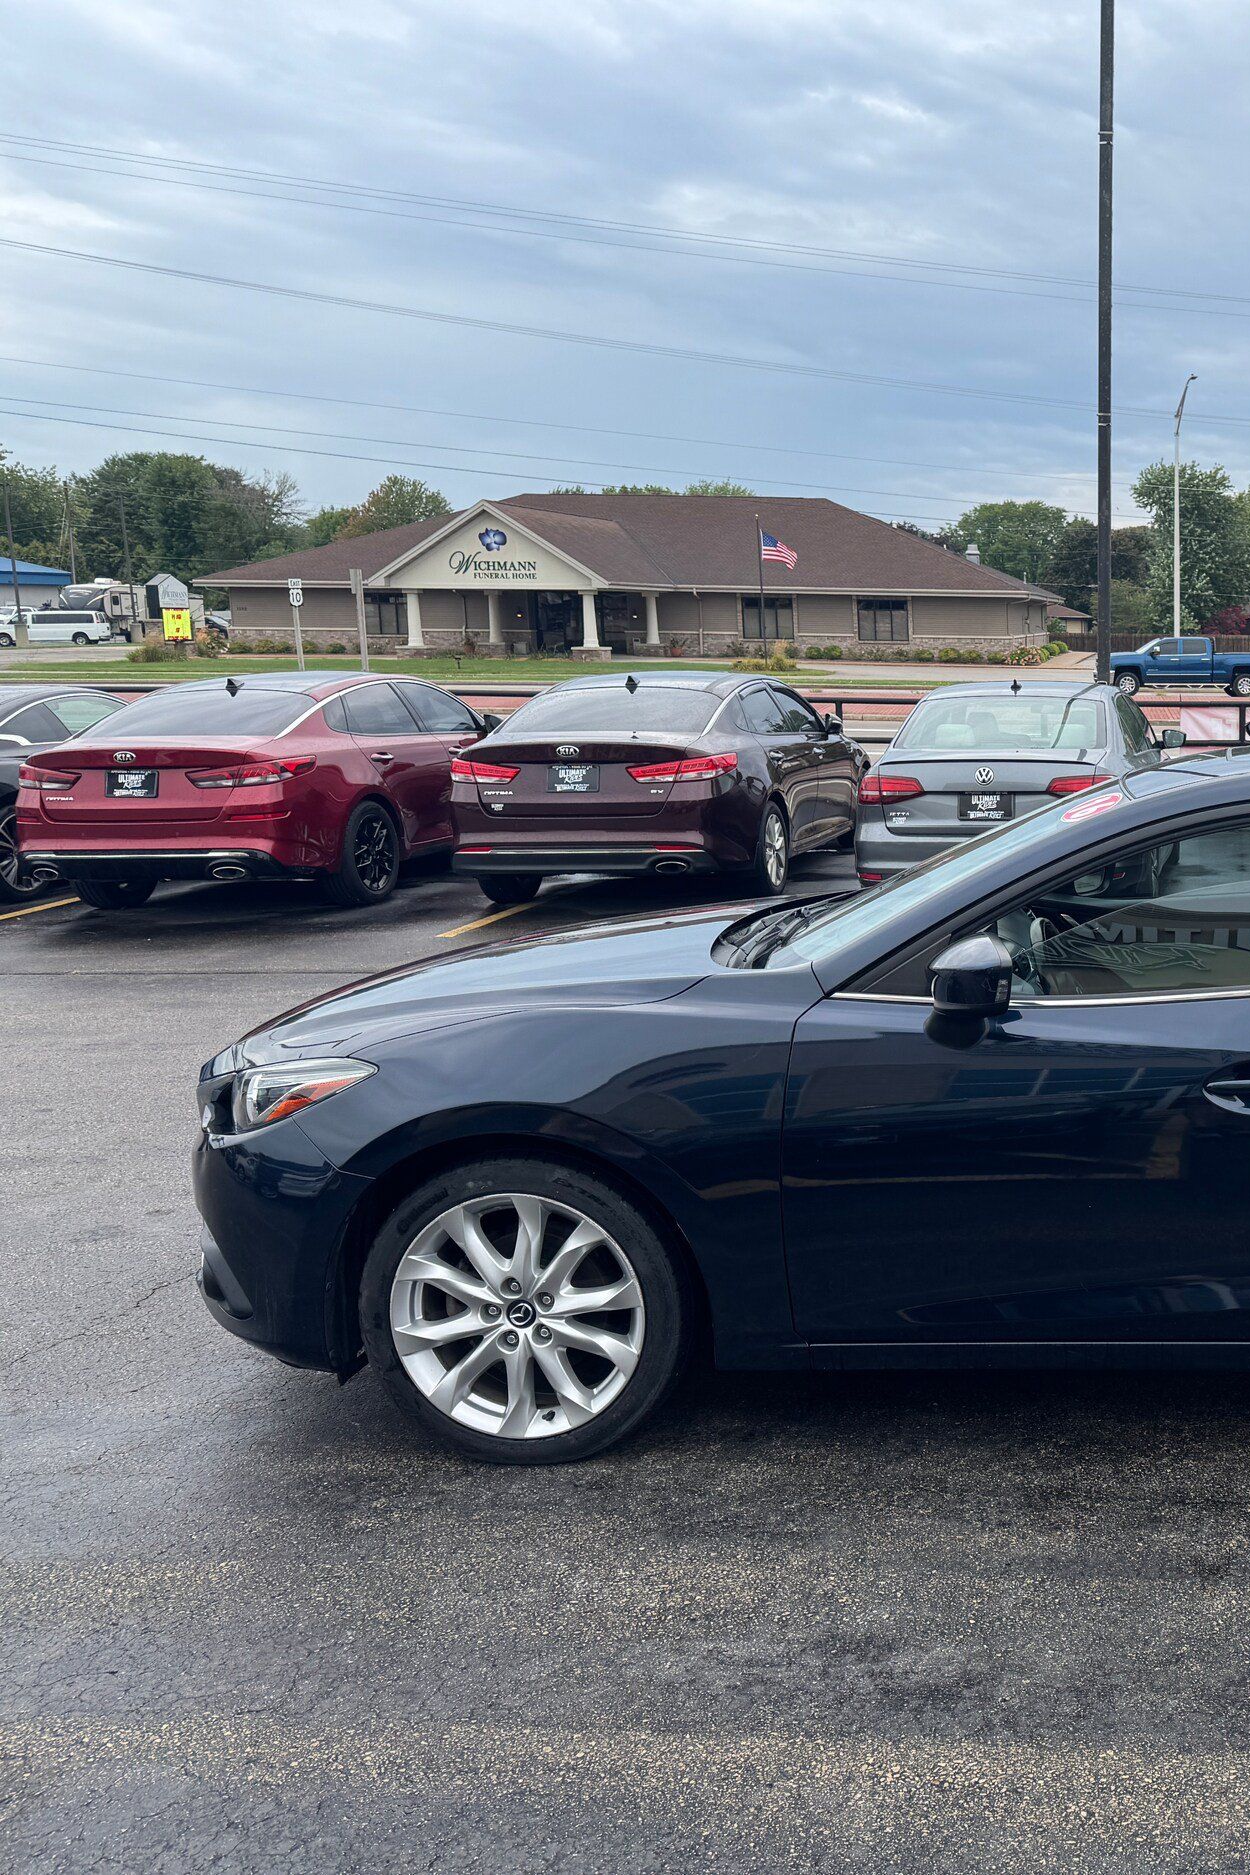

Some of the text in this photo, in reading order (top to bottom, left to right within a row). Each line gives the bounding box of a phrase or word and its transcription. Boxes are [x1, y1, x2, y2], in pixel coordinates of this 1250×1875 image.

[291, 592, 301, 603] 10
[559, 747, 575, 755] KIA
[116, 753, 132, 761] KIA
[558, 768, 587, 779] ULTIMATE
[117, 774, 146, 784] ULTIMATE
[971, 794, 1001, 805] ULTIMATE
